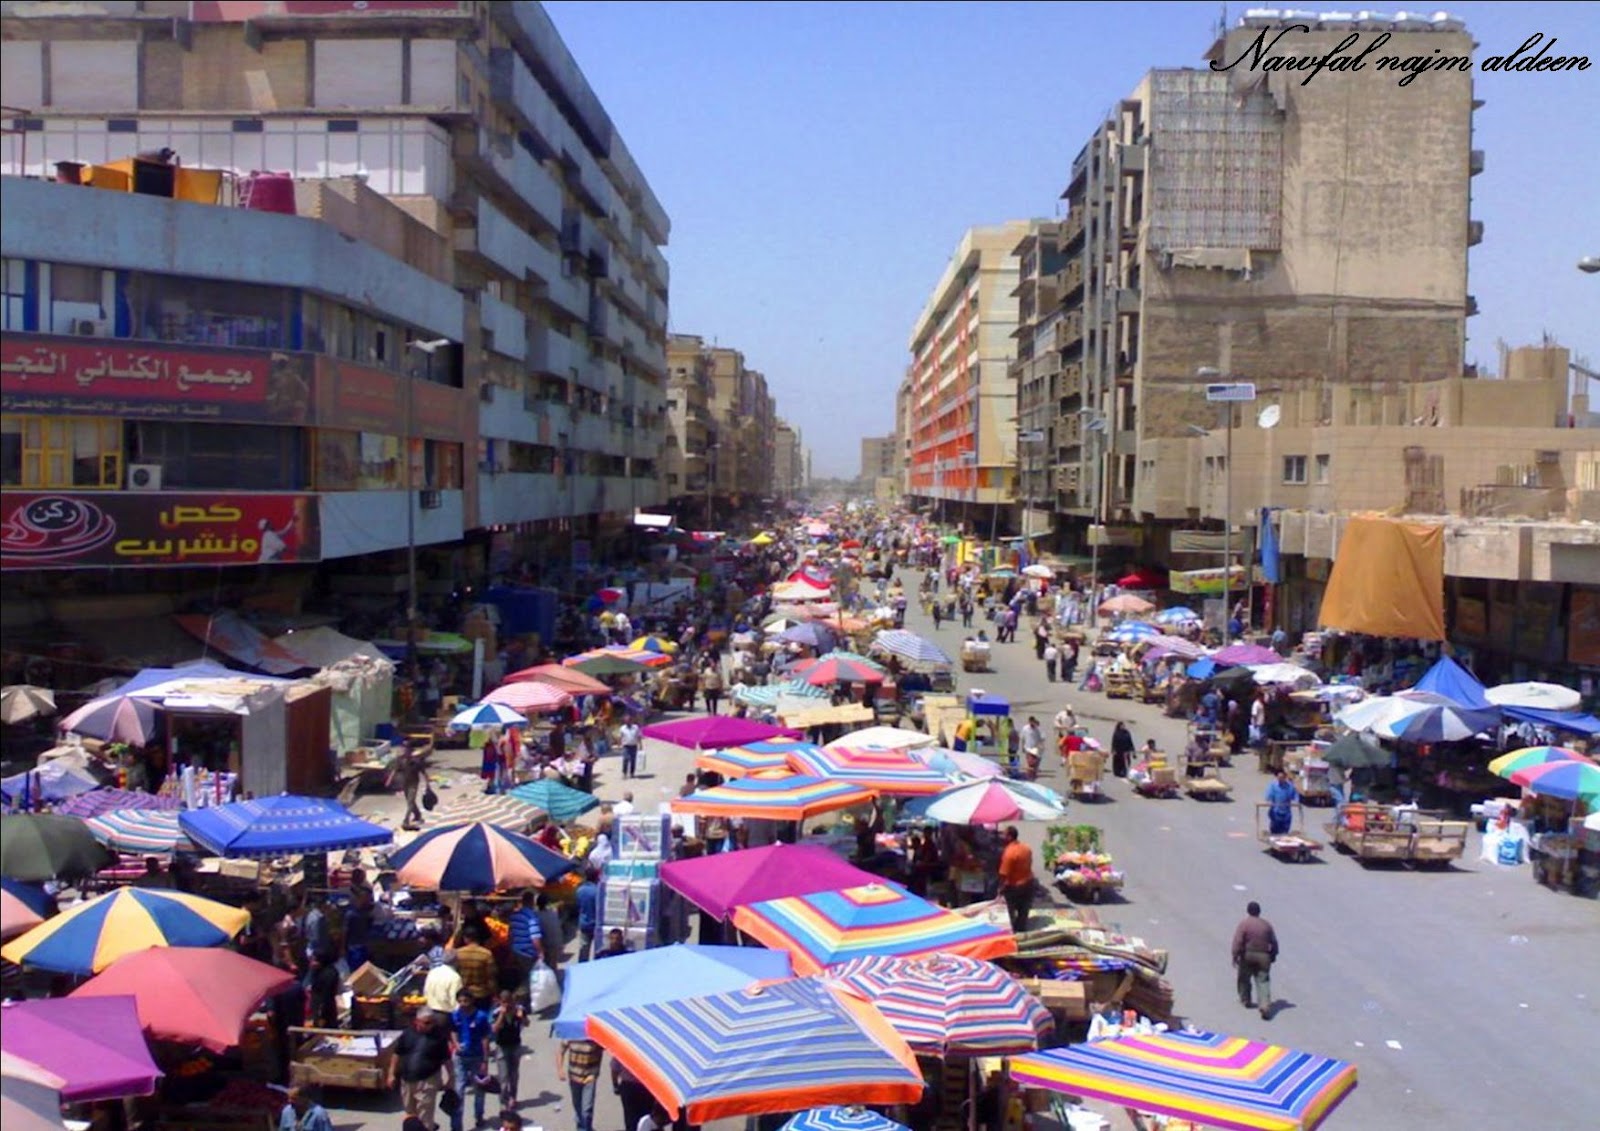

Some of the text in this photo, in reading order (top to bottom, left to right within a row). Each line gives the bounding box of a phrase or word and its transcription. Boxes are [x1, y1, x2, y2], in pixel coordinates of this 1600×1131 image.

[75, 351, 169, 387] الكناني
[176, 365, 253, 392] مجمع
[32, 501, 77, 523] ركن
